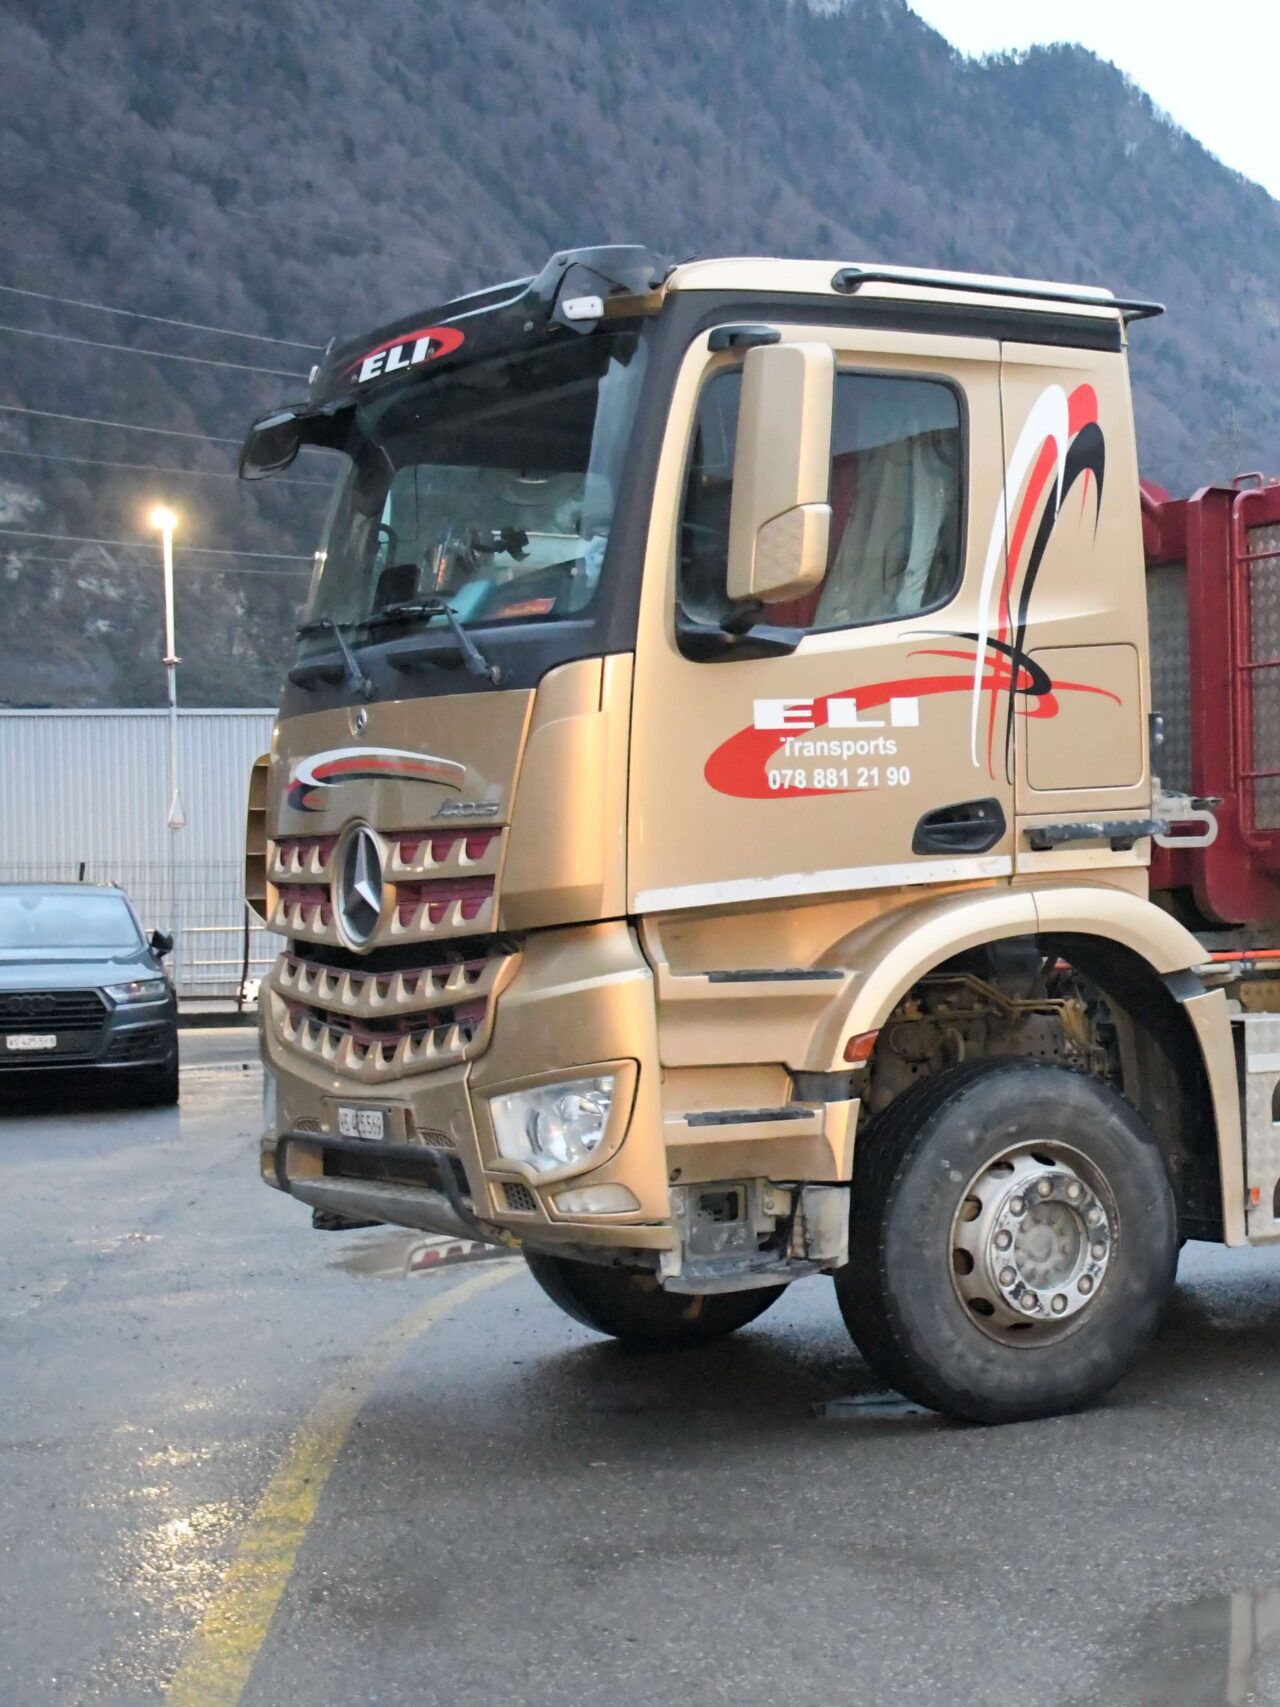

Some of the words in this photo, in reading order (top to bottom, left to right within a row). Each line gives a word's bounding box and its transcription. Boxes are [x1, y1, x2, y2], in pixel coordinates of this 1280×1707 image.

[359, 336, 430, 383] ELI
[753, 696, 919, 730] ELI
[779, 736, 898, 760] Transports
[768, 769, 807, 790] 078
[813, 768, 849, 789] 881
[857, 767, 879, 787] 21
[886, 766, 911, 786] 90
